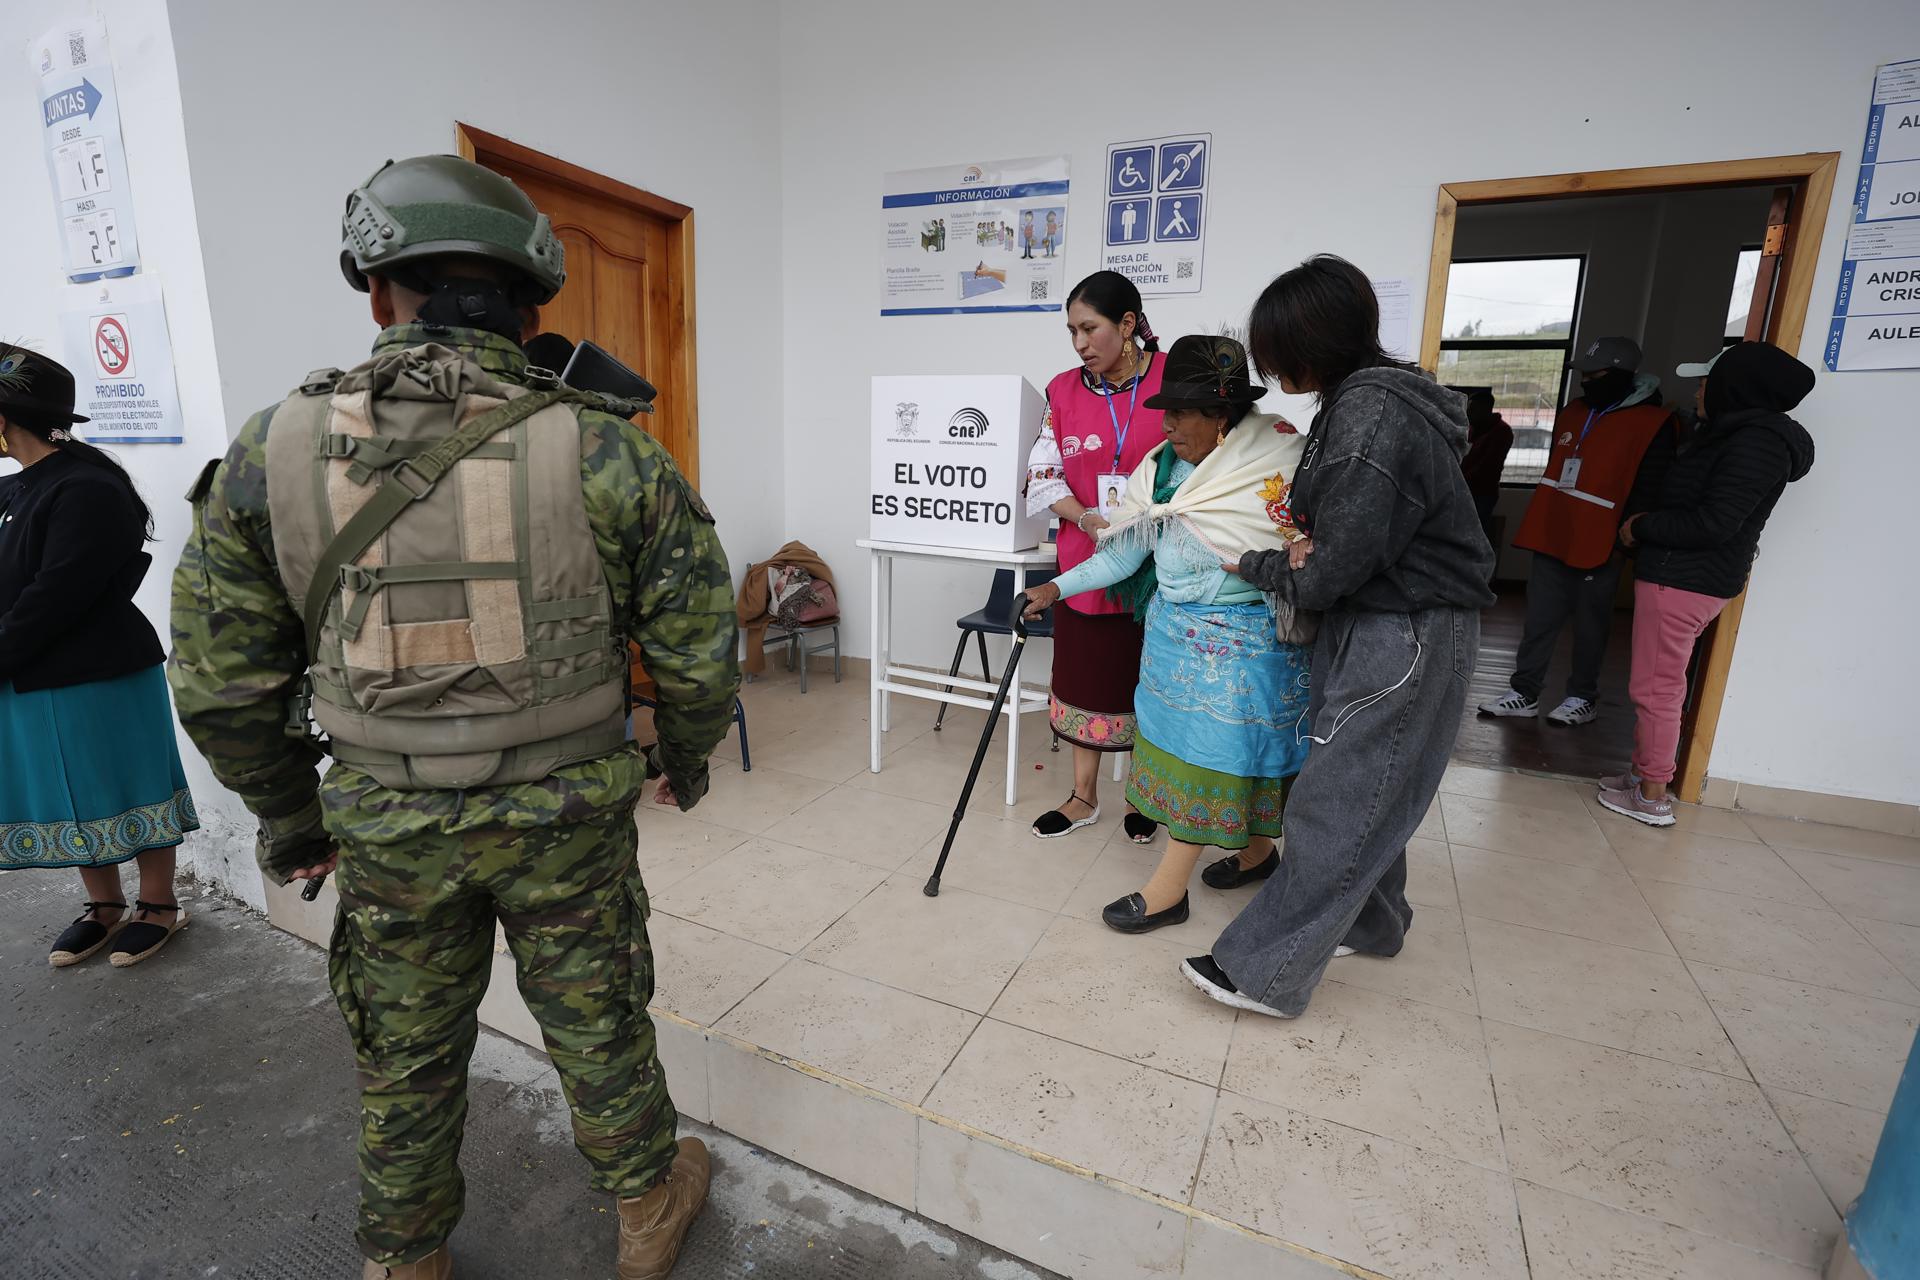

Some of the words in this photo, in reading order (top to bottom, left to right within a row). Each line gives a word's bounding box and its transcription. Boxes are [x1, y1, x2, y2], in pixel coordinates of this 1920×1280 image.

[47, 90, 85, 122] JUNTAS
[62, 127, 81, 141] DESDE
[1867, 115, 1879, 152] DESDE
[91, 153, 104, 187] F
[77, 200, 96, 213] HASTA
[935, 187, 1010, 203] INFORMACIÓN
[1856, 179, 1869, 215] HASTA
[89, 230, 102, 264] 2
[105, 225, 116, 258] F
[1107, 254, 1134, 264] MESA
[1136, 253, 1149, 262] DE
[1839, 270, 1851, 306] DESDE
[1827, 331, 1840, 365] HASTA
[95, 383, 145, 398] PROHIBIDO
[133, 422, 144, 431] DEL
[144, 422, 158, 430] VOTO
[949, 426, 975, 438] CNE
[895, 463, 920, 485] EL
[925, 464, 987, 488] VOTO
[872, 494, 899, 516] ES
[904, 496, 1011, 525] SECRETO
